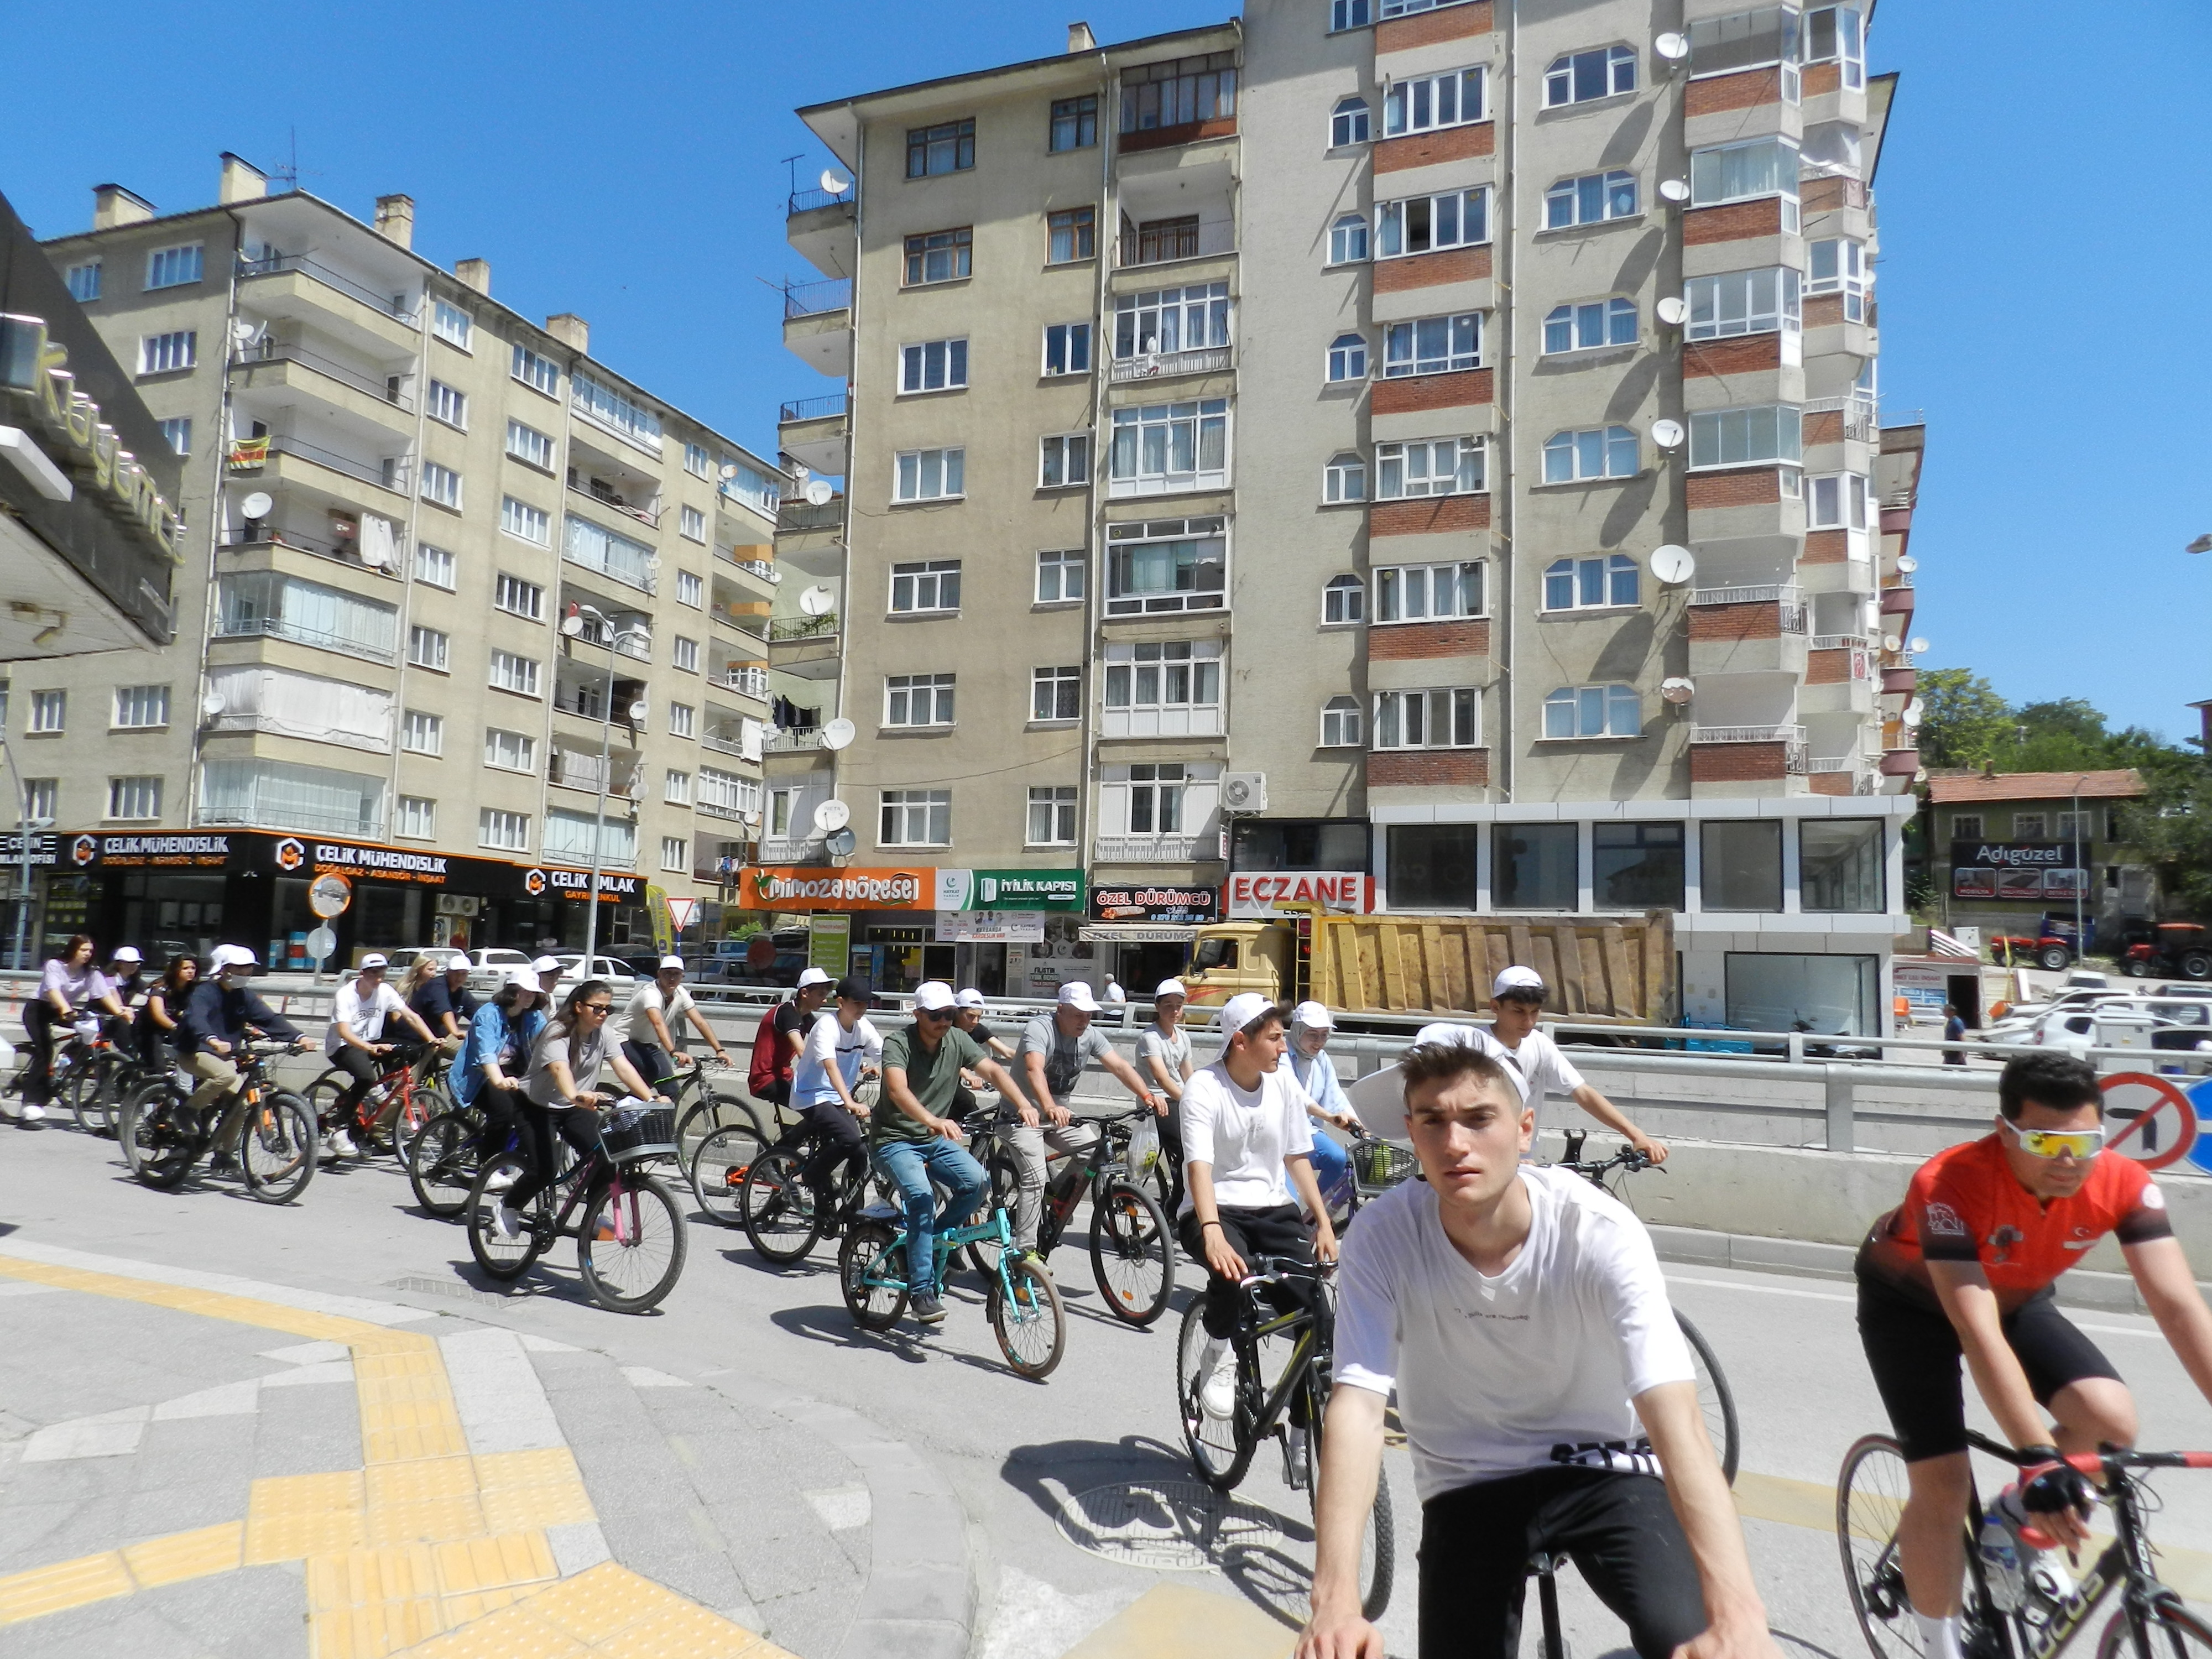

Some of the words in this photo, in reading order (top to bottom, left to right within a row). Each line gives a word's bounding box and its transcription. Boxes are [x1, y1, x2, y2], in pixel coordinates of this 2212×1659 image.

[105, 837, 139, 853] ÇELİK
[141, 836, 229, 852] MÜHENDİSLİK
[316, 844, 357, 864] ÇELİK
[358, 848, 447, 873] MÜHENDİSLİK
[314, 863, 364, 877] DOĞALGAZ
[371, 869, 411, 881] ASANSÖR
[417, 872, 446, 884] İNŞAAT
[551, 870, 588, 889] ÇELİK
[597, 875, 635, 893] MLAK
[1001, 878, 1034, 892] İYİLİK
[1036, 880, 1077, 891] KAPISI
[1235, 876, 1357, 901] ECZANE
[565, 890, 620, 902] GAYRİENKUL
[1097, 890, 1132, 905] ÖZEL
[1134, 888, 1211, 907] DÜRÜMCÜ
